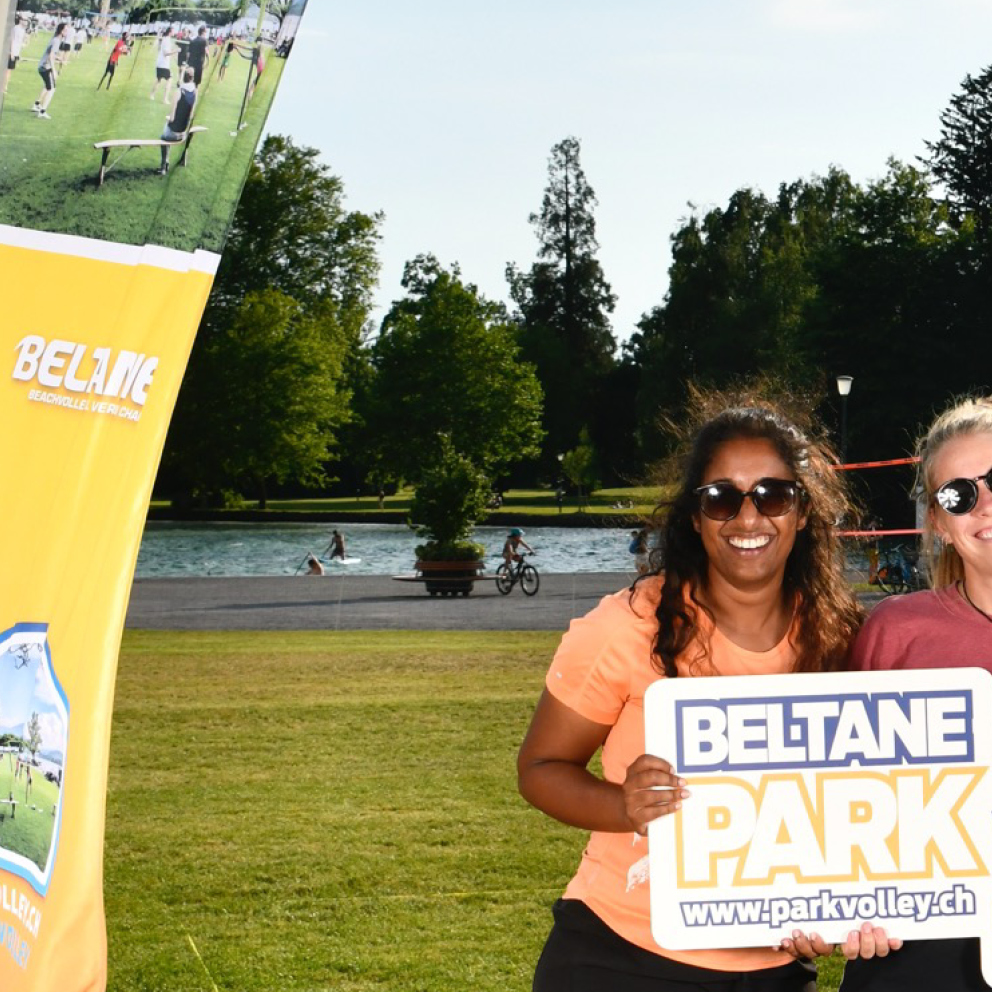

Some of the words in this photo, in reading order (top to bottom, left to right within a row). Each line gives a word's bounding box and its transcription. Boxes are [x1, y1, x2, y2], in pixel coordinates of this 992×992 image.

[675, 690, 975, 773] BELTANE
[675, 766, 990, 888] PARK
[680, 884, 976, 928] www.parkvolley.ch
